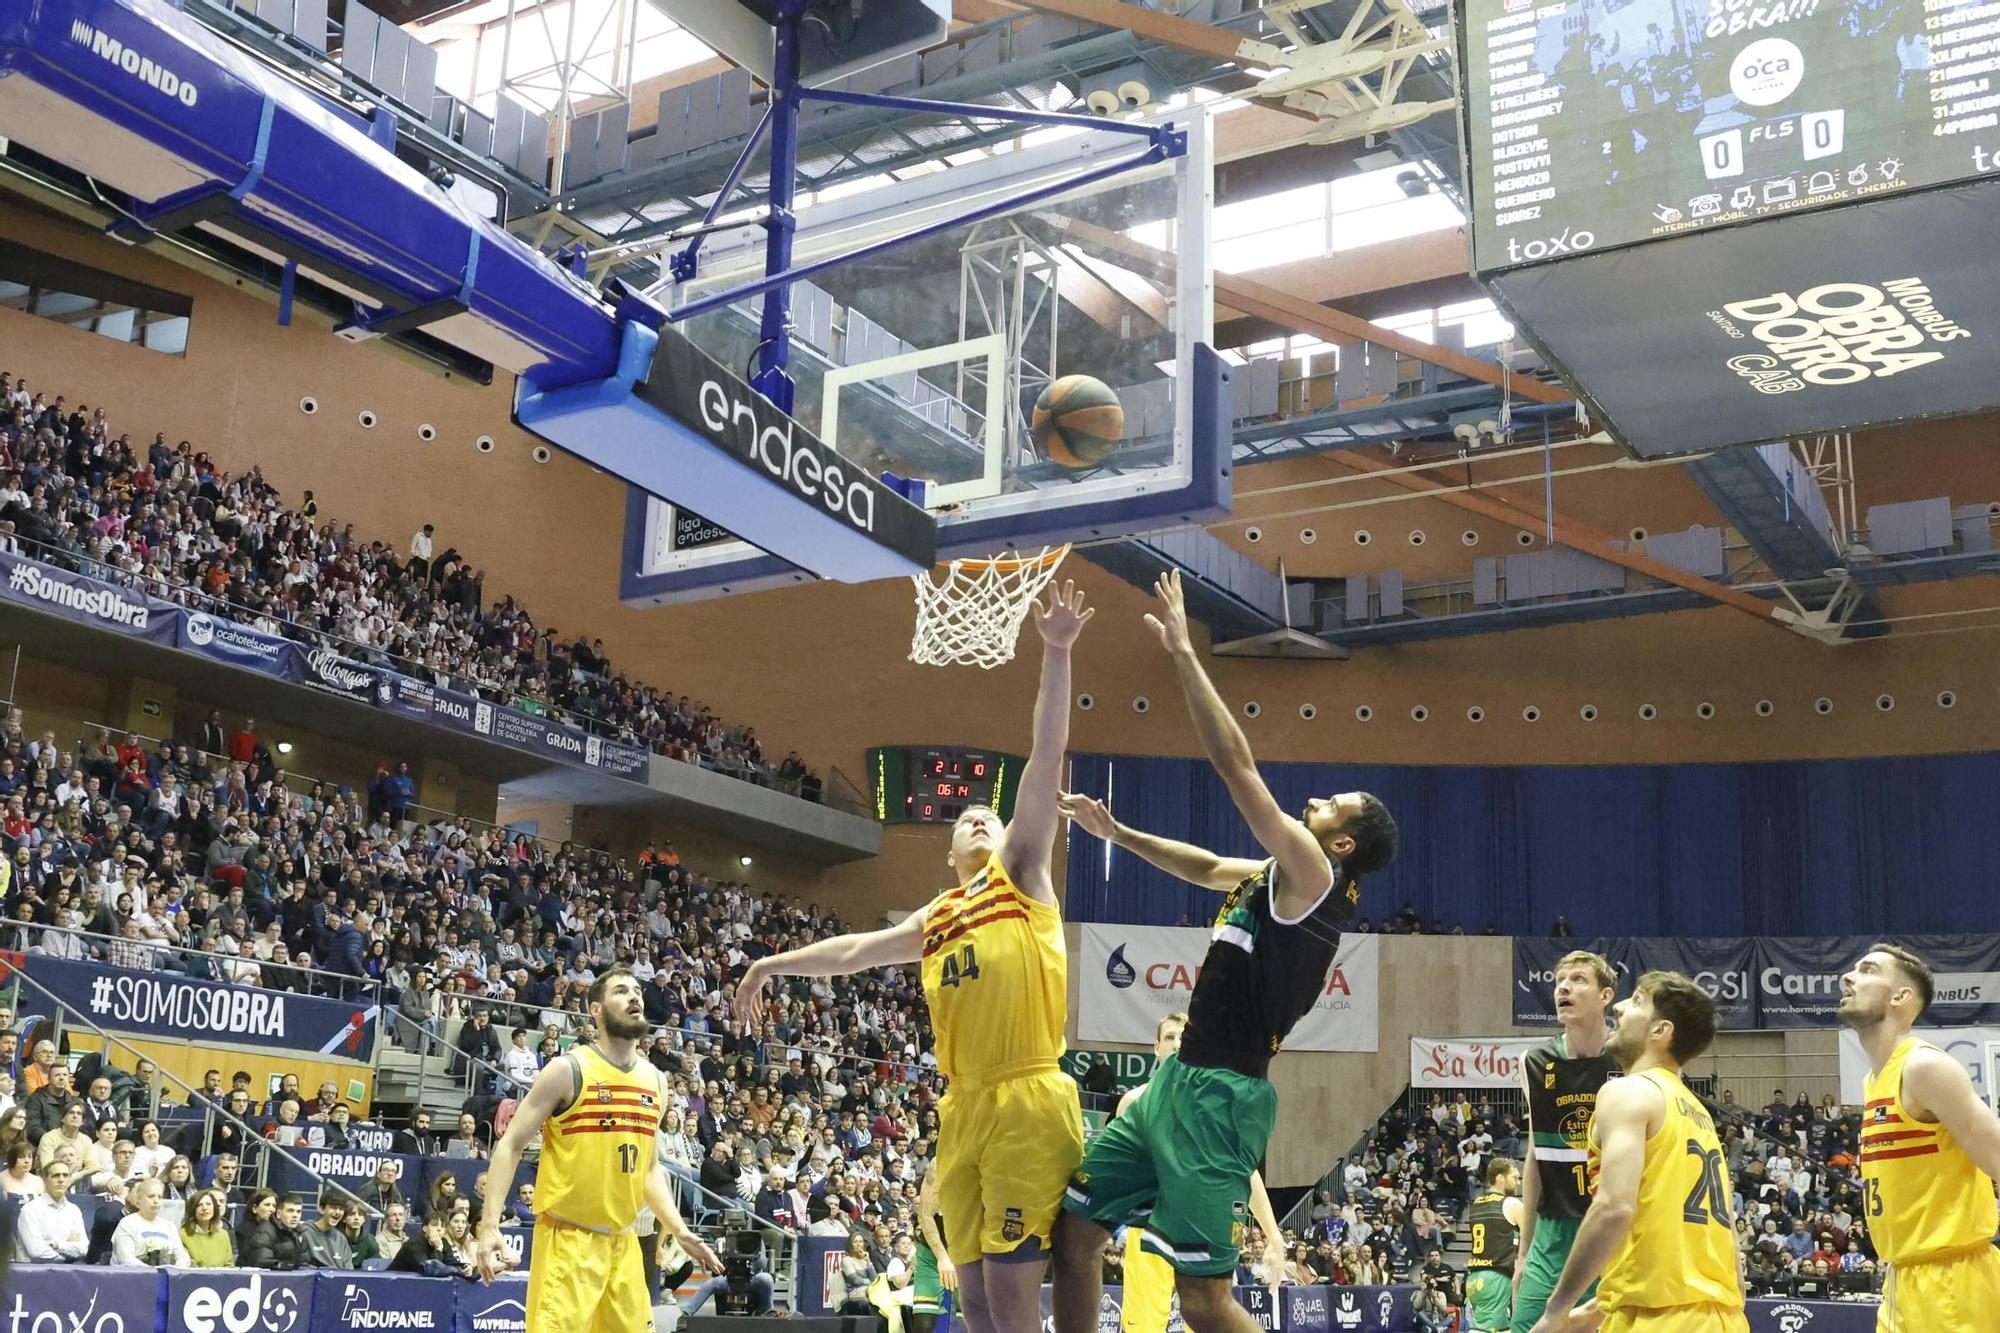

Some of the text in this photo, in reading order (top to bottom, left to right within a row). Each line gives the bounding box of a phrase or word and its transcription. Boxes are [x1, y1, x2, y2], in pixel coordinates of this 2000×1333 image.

[91, 29, 198, 107] MONDO
[1492, 124, 1538, 144] DOTSON
[1749, 121, 1794, 143] FLS
[1814, 119, 1830, 148] 0
[1493, 138, 1548, 160] BLAZEVIC
[1602, 142, 1611, 154] 2
[1713, 140, 1730, 169] 0
[1493, 154, 1551, 176] PUSTOVYI
[1756, 206, 1770, 216] TV
[1778, 190, 1848, 211] SEGURIDADE
[1652, 218, 1705, 234] INTERNET
[1507, 227, 1595, 262] toxo
[1881, 276, 1971, 342] MONBUS
[1705, 310, 1745, 339] SANTIAGO
[1797, 283, 1945, 377] OBRA
[1726, 354, 1806, 394] CAB
[699, 380, 874, 533] endesa
[678, 518, 701, 532] liga
[9, 563, 149, 629] #SomosObra
[216, 629, 279, 655] ocahotels.com
[308, 650, 372, 690] Milongas
[547, 733, 581, 753] GRADA
[90, 976, 284, 1037] #SOMOSOBRA
[1422, 1044, 1466, 1081] La
[1473, 1223, 1486, 1254] 8
[351, 1310, 435, 1328] INDUPANEL
[1306, 1299, 1325, 1312] JAEL
